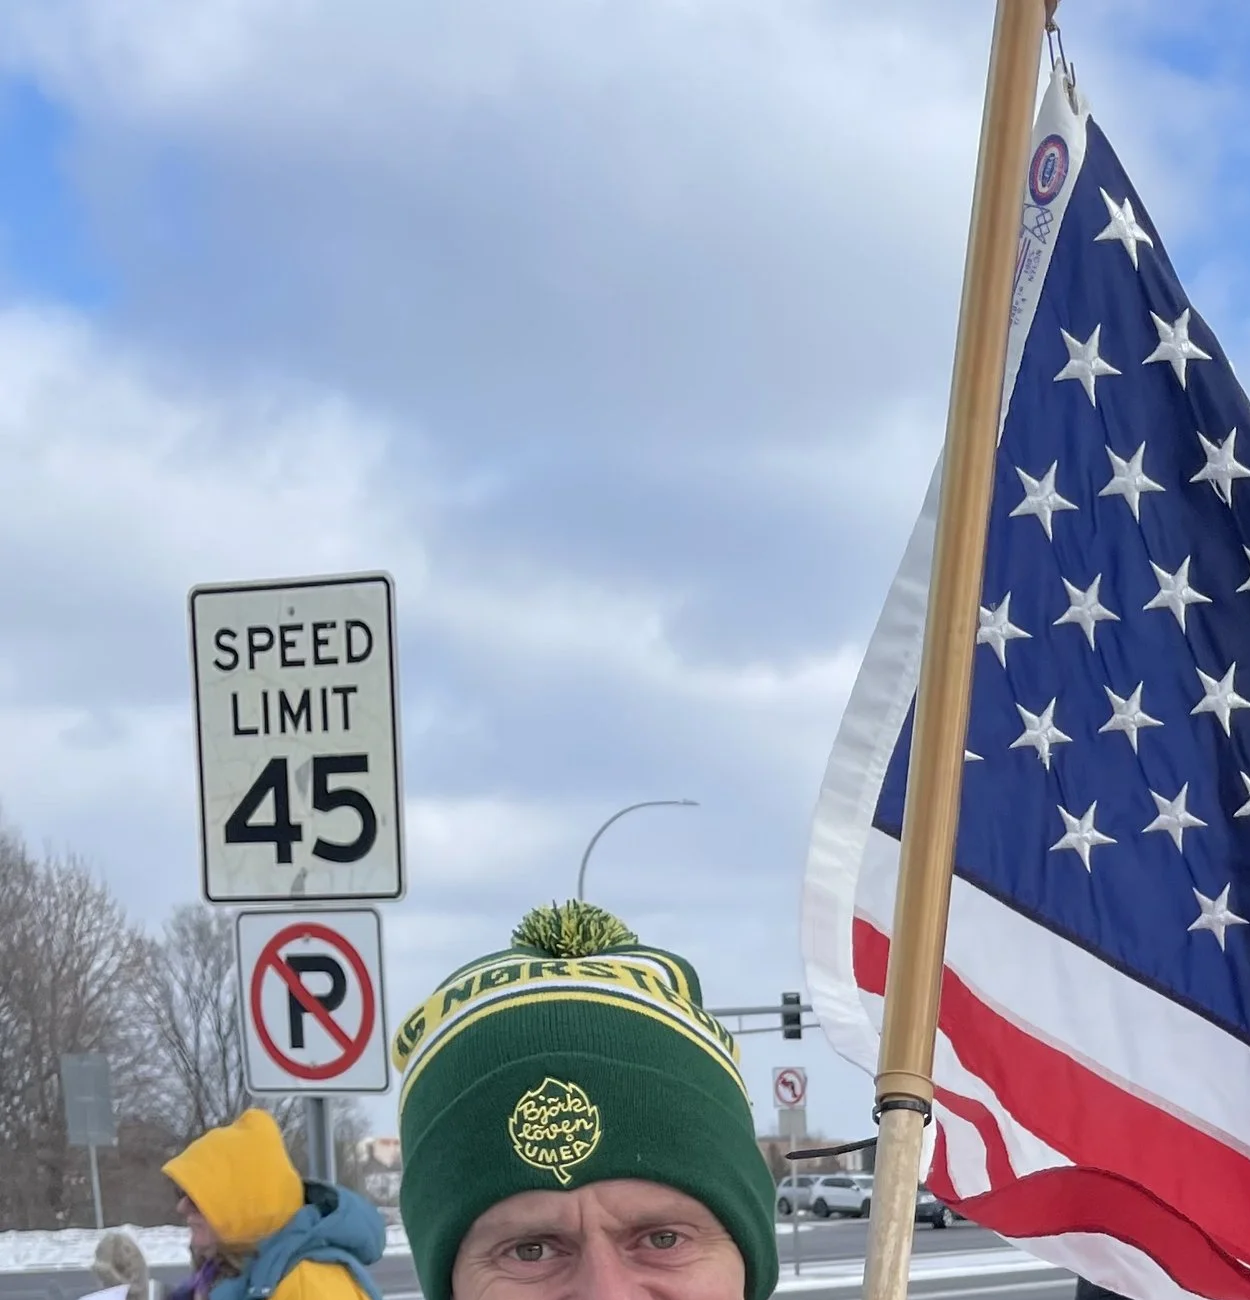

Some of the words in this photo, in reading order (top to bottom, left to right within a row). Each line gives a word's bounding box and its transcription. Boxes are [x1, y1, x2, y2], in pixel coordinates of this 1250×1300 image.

[213, 620, 373, 671] SPEED
[231, 686, 358, 735] LIMIT
[224, 754, 377, 864] 45
[286, 955, 347, 1048] P
[517, 1094, 587, 1125] Björk
[518, 1119, 594, 1141] löven
[525, 1134, 591, 1163] UMEÅ
